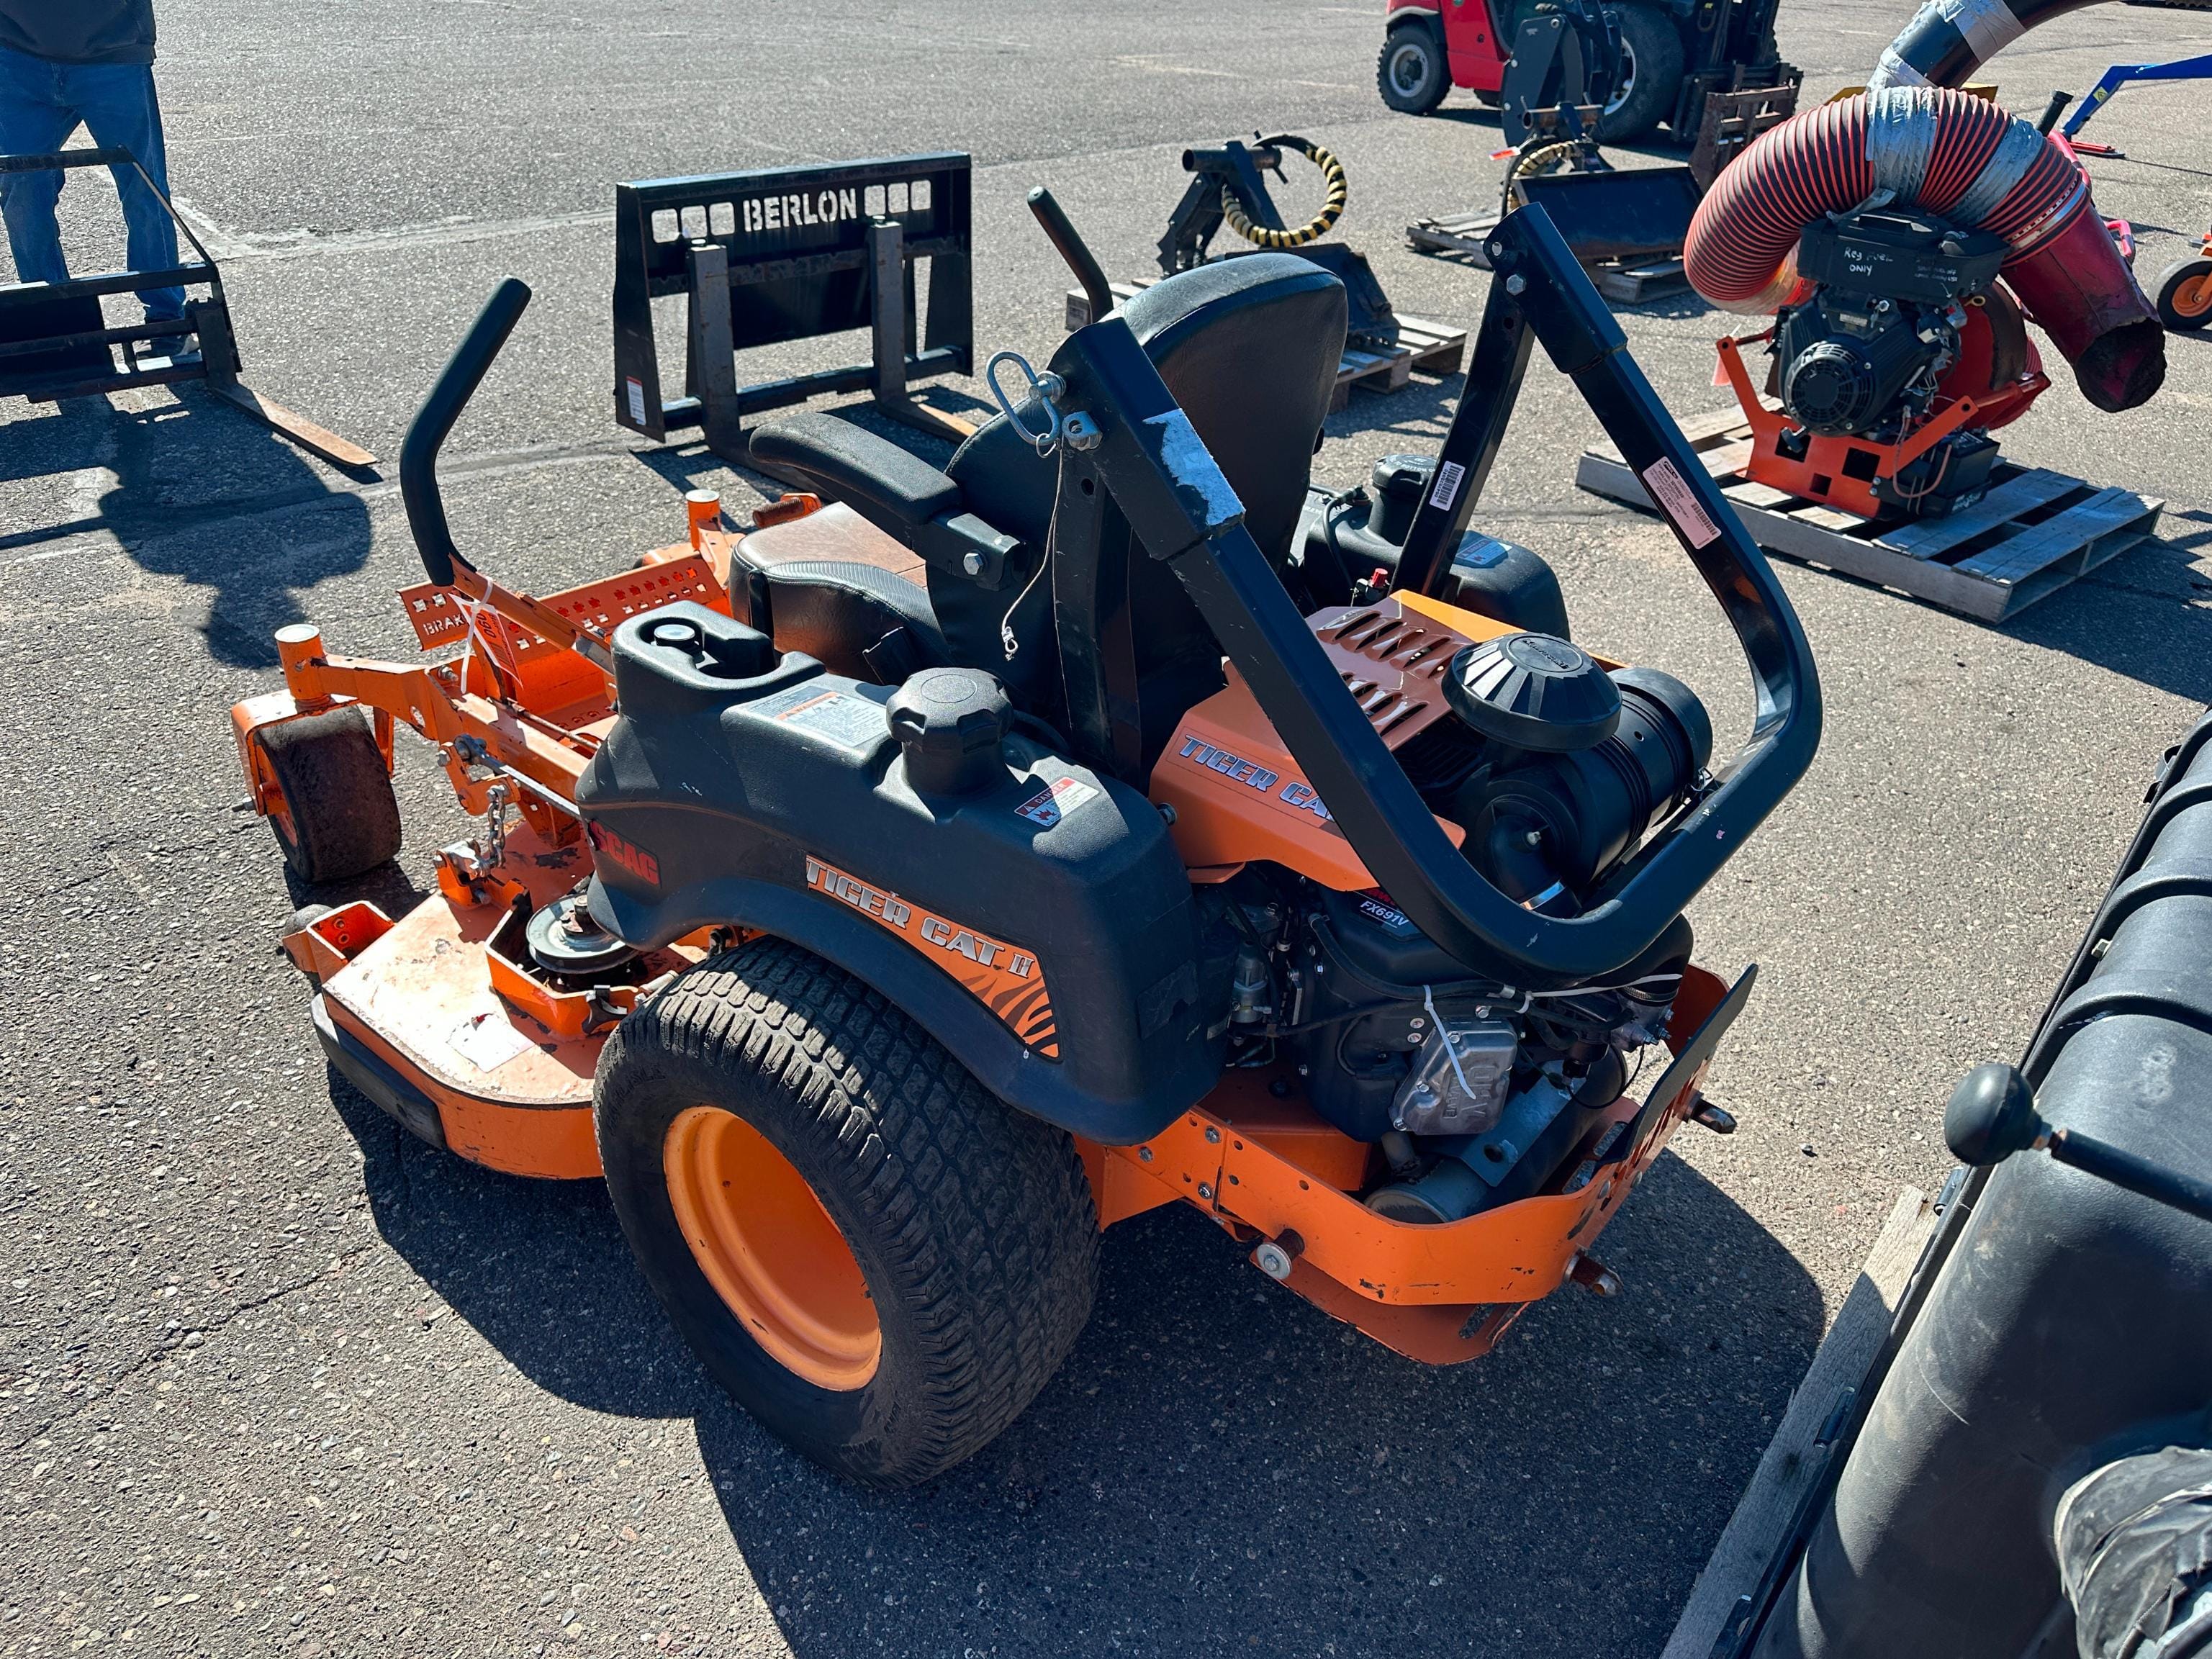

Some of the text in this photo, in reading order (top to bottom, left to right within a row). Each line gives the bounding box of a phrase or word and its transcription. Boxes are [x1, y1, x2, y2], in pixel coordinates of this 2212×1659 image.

[744, 188, 857, 232] BERLON
[1035, 782, 1068, 805] DANGER
[1178, 734, 1335, 823] TIGER CA
[590, 820, 660, 885] SCAG
[805, 858, 911, 929] TIGER
[921, 916, 1005, 967] CAT
[1359, 900, 1410, 927] FX691V
